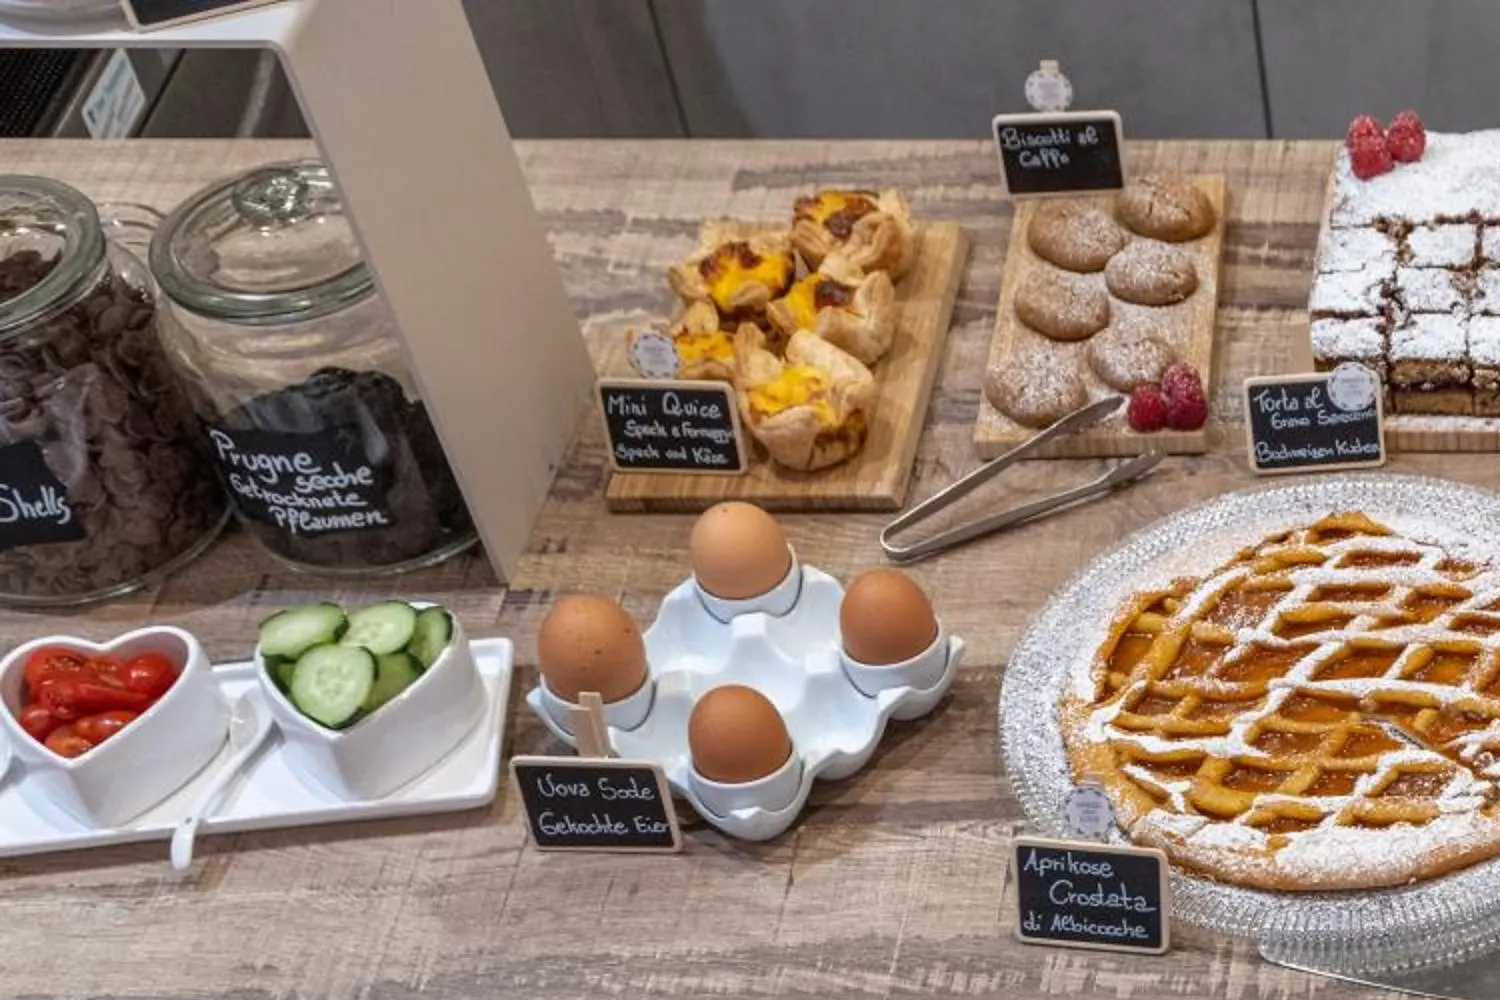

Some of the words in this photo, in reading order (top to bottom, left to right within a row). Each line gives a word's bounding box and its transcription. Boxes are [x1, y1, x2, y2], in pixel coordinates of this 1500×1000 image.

[607, 394, 647, 416] Mini
[1253, 387, 1300, 413] Torta
[209, 429, 322, 485] Prugne
[615, 443, 660, 461] Speck
[268, 505, 389, 535] Pflaumen
[597, 776, 656, 801] Sode
[538, 811, 629, 836] Gekochte
[1023, 848, 1115, 879] Aprikose
[1049, 879, 1158, 914] Crostata
[1023, 910, 1042, 932] di
